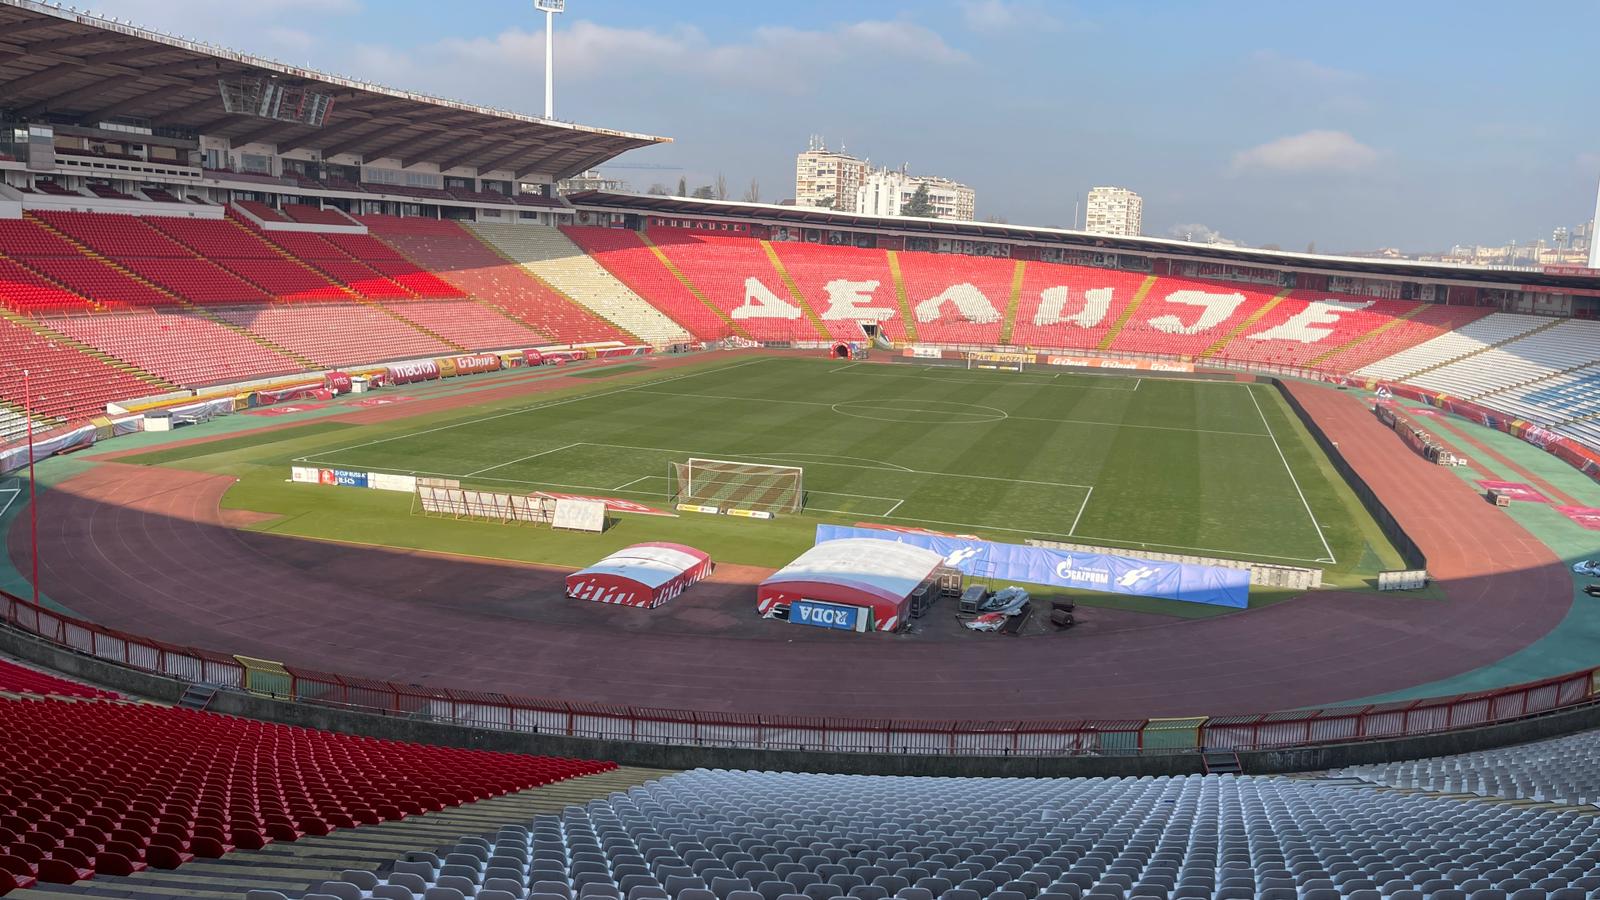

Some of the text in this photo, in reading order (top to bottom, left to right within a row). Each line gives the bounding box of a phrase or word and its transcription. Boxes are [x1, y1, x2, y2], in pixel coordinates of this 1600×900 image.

[731, 276, 1376, 343] ДЕЛИЈЕ
[333, 377, 348, 385] mts
[1071, 570, 1109, 584] GAZPROM
[799, 605, 848, 625] RODA
